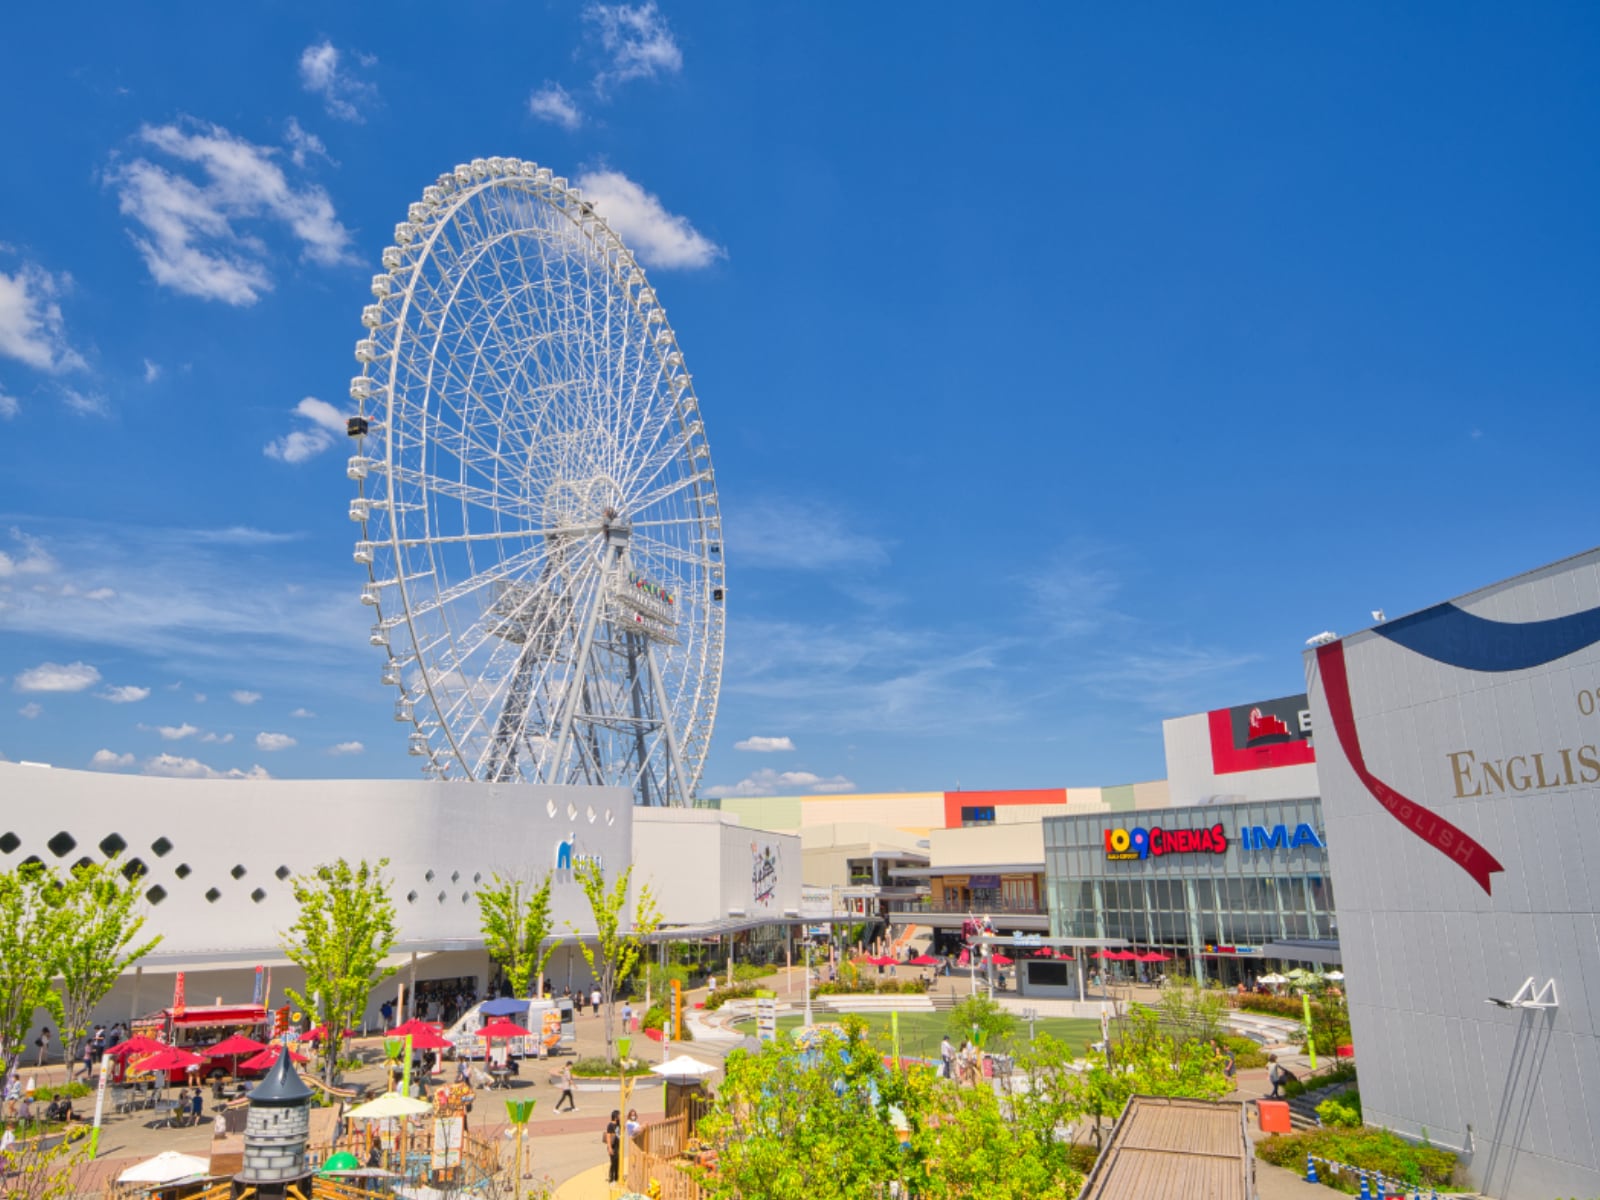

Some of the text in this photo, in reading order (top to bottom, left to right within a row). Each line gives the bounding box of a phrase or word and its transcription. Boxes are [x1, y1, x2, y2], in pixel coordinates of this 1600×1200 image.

[1577, 688, 1600, 716] O
[1241, 823, 1327, 850] IMA
[1374, 785, 1474, 862] ENGLISH
[1104, 823, 1228, 860] 109 CINEMAS
